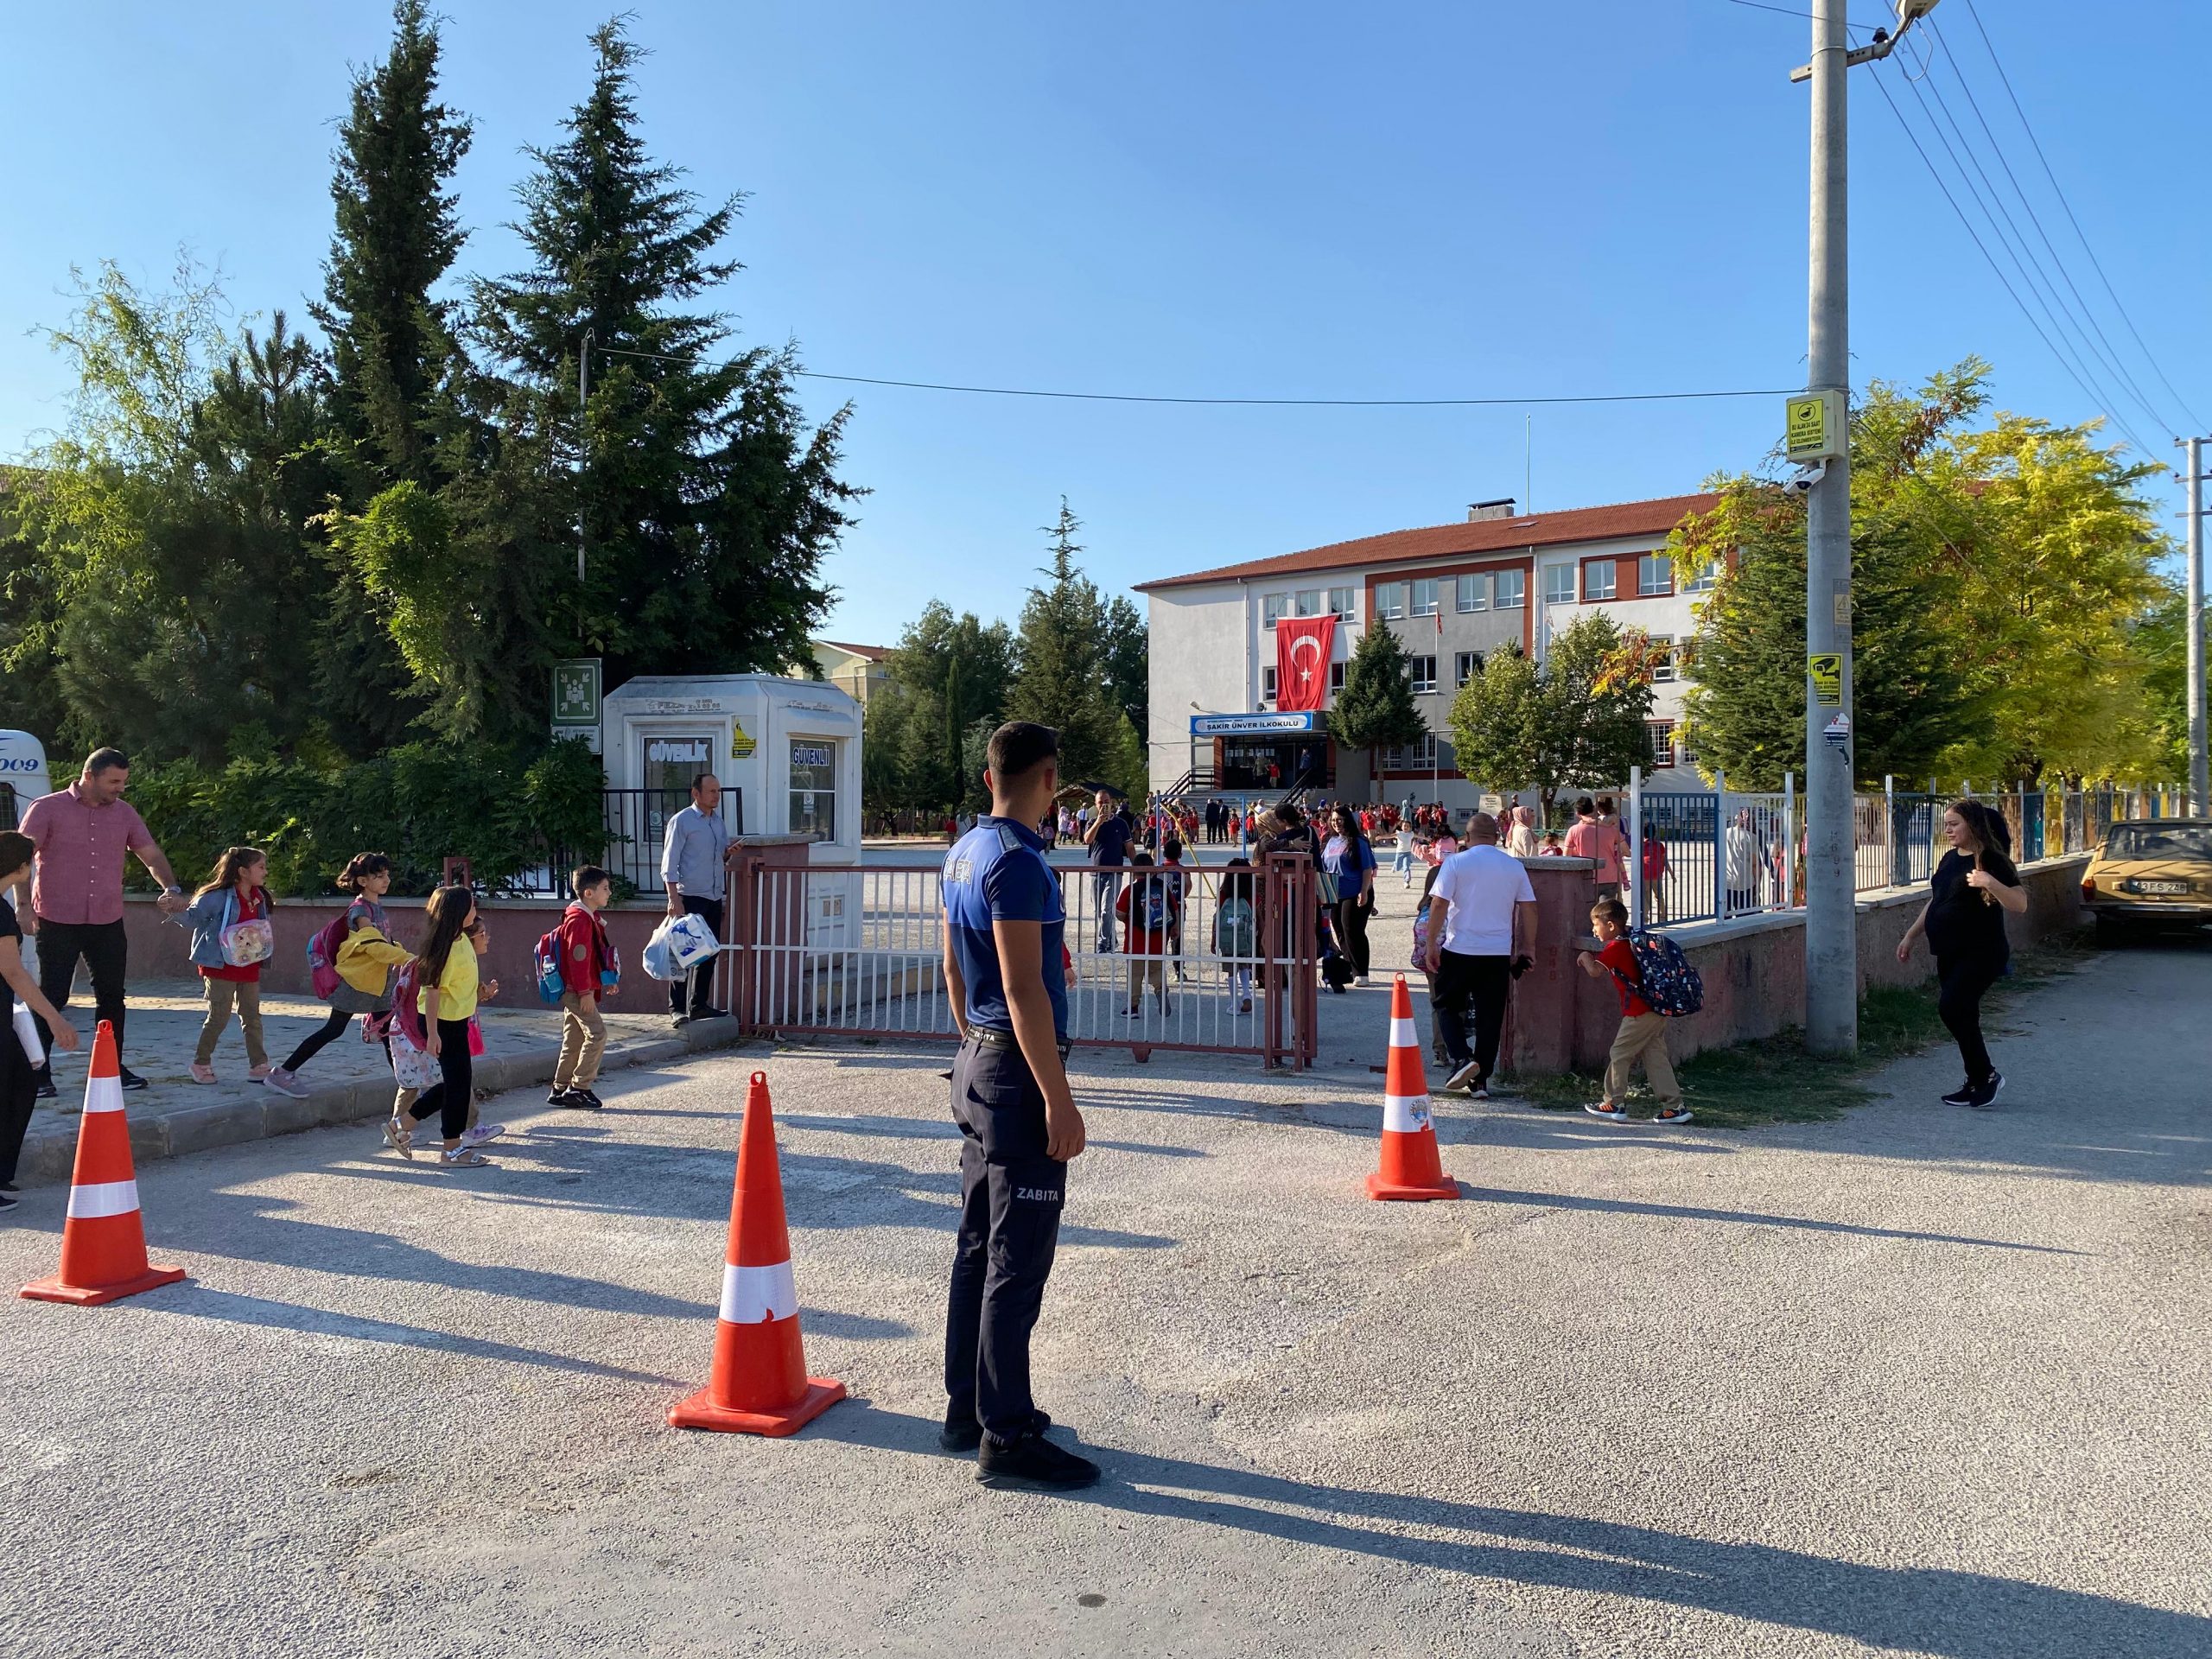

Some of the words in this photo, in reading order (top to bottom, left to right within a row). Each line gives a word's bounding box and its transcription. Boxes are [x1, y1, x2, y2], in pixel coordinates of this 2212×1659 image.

[1207, 722, 1230, 731] ŞAKİR
[649, 740, 709, 761] GÜVENLİK
[943, 859, 973, 885] ZABA
[974, 1030, 995, 1042] ZAITA
[1017, 1187, 1058, 1202] ZABITA
